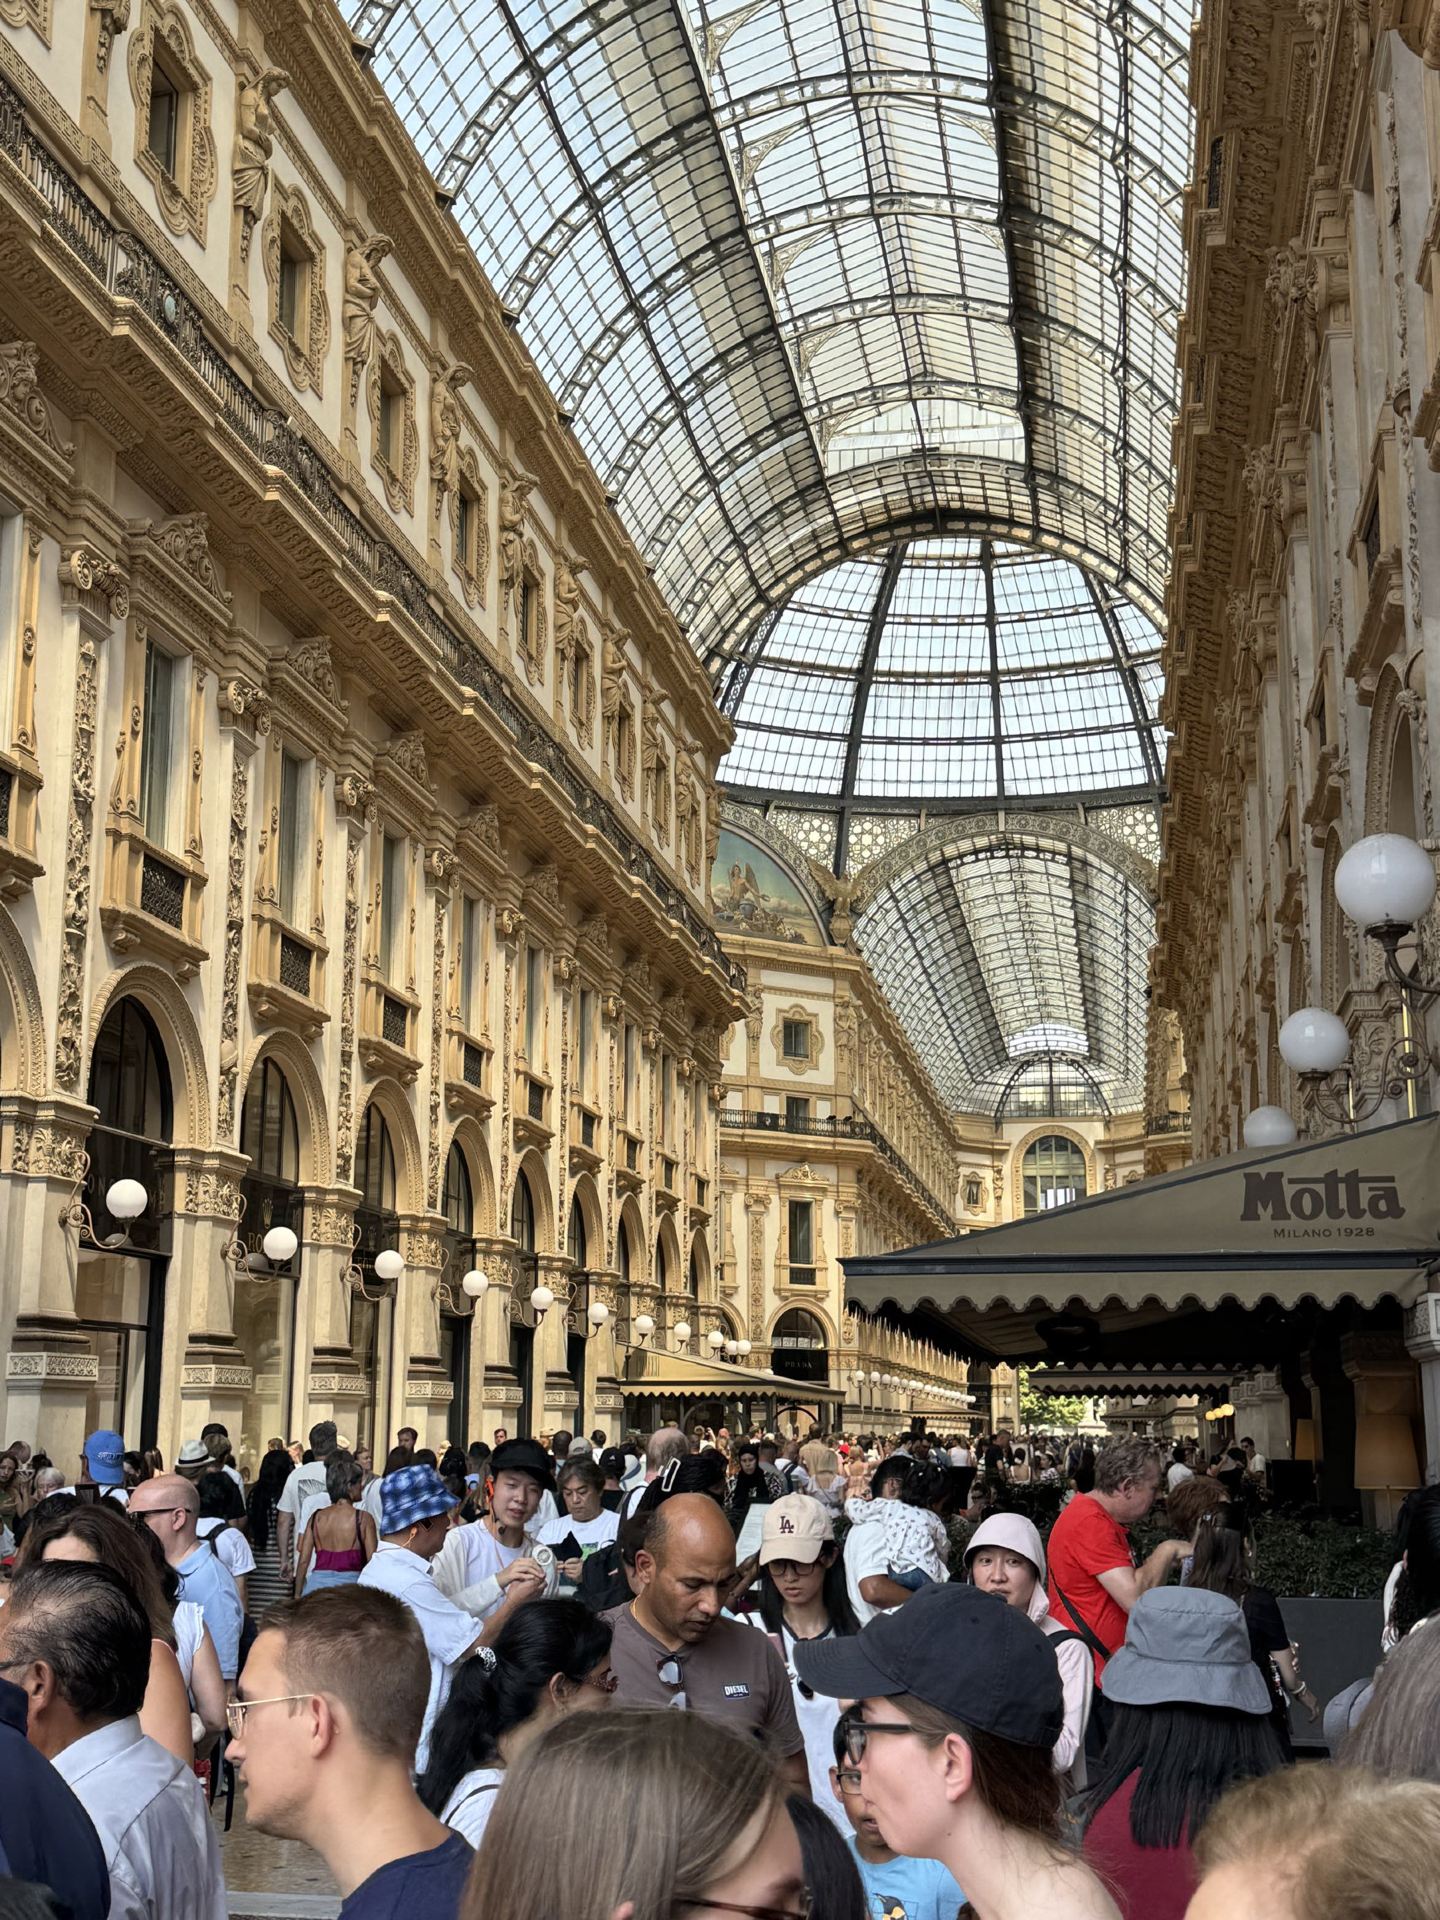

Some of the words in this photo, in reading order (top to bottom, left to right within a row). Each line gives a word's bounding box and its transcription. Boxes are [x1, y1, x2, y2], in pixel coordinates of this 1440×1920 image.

[1240, 1168, 1406, 1221] Motta
[1274, 1228, 1332, 1239] MILANO
[1337, 1227, 1375, 1238] 1928
[779, 1515, 794, 1533] LA
[725, 1685, 748, 1696] DIESEL
